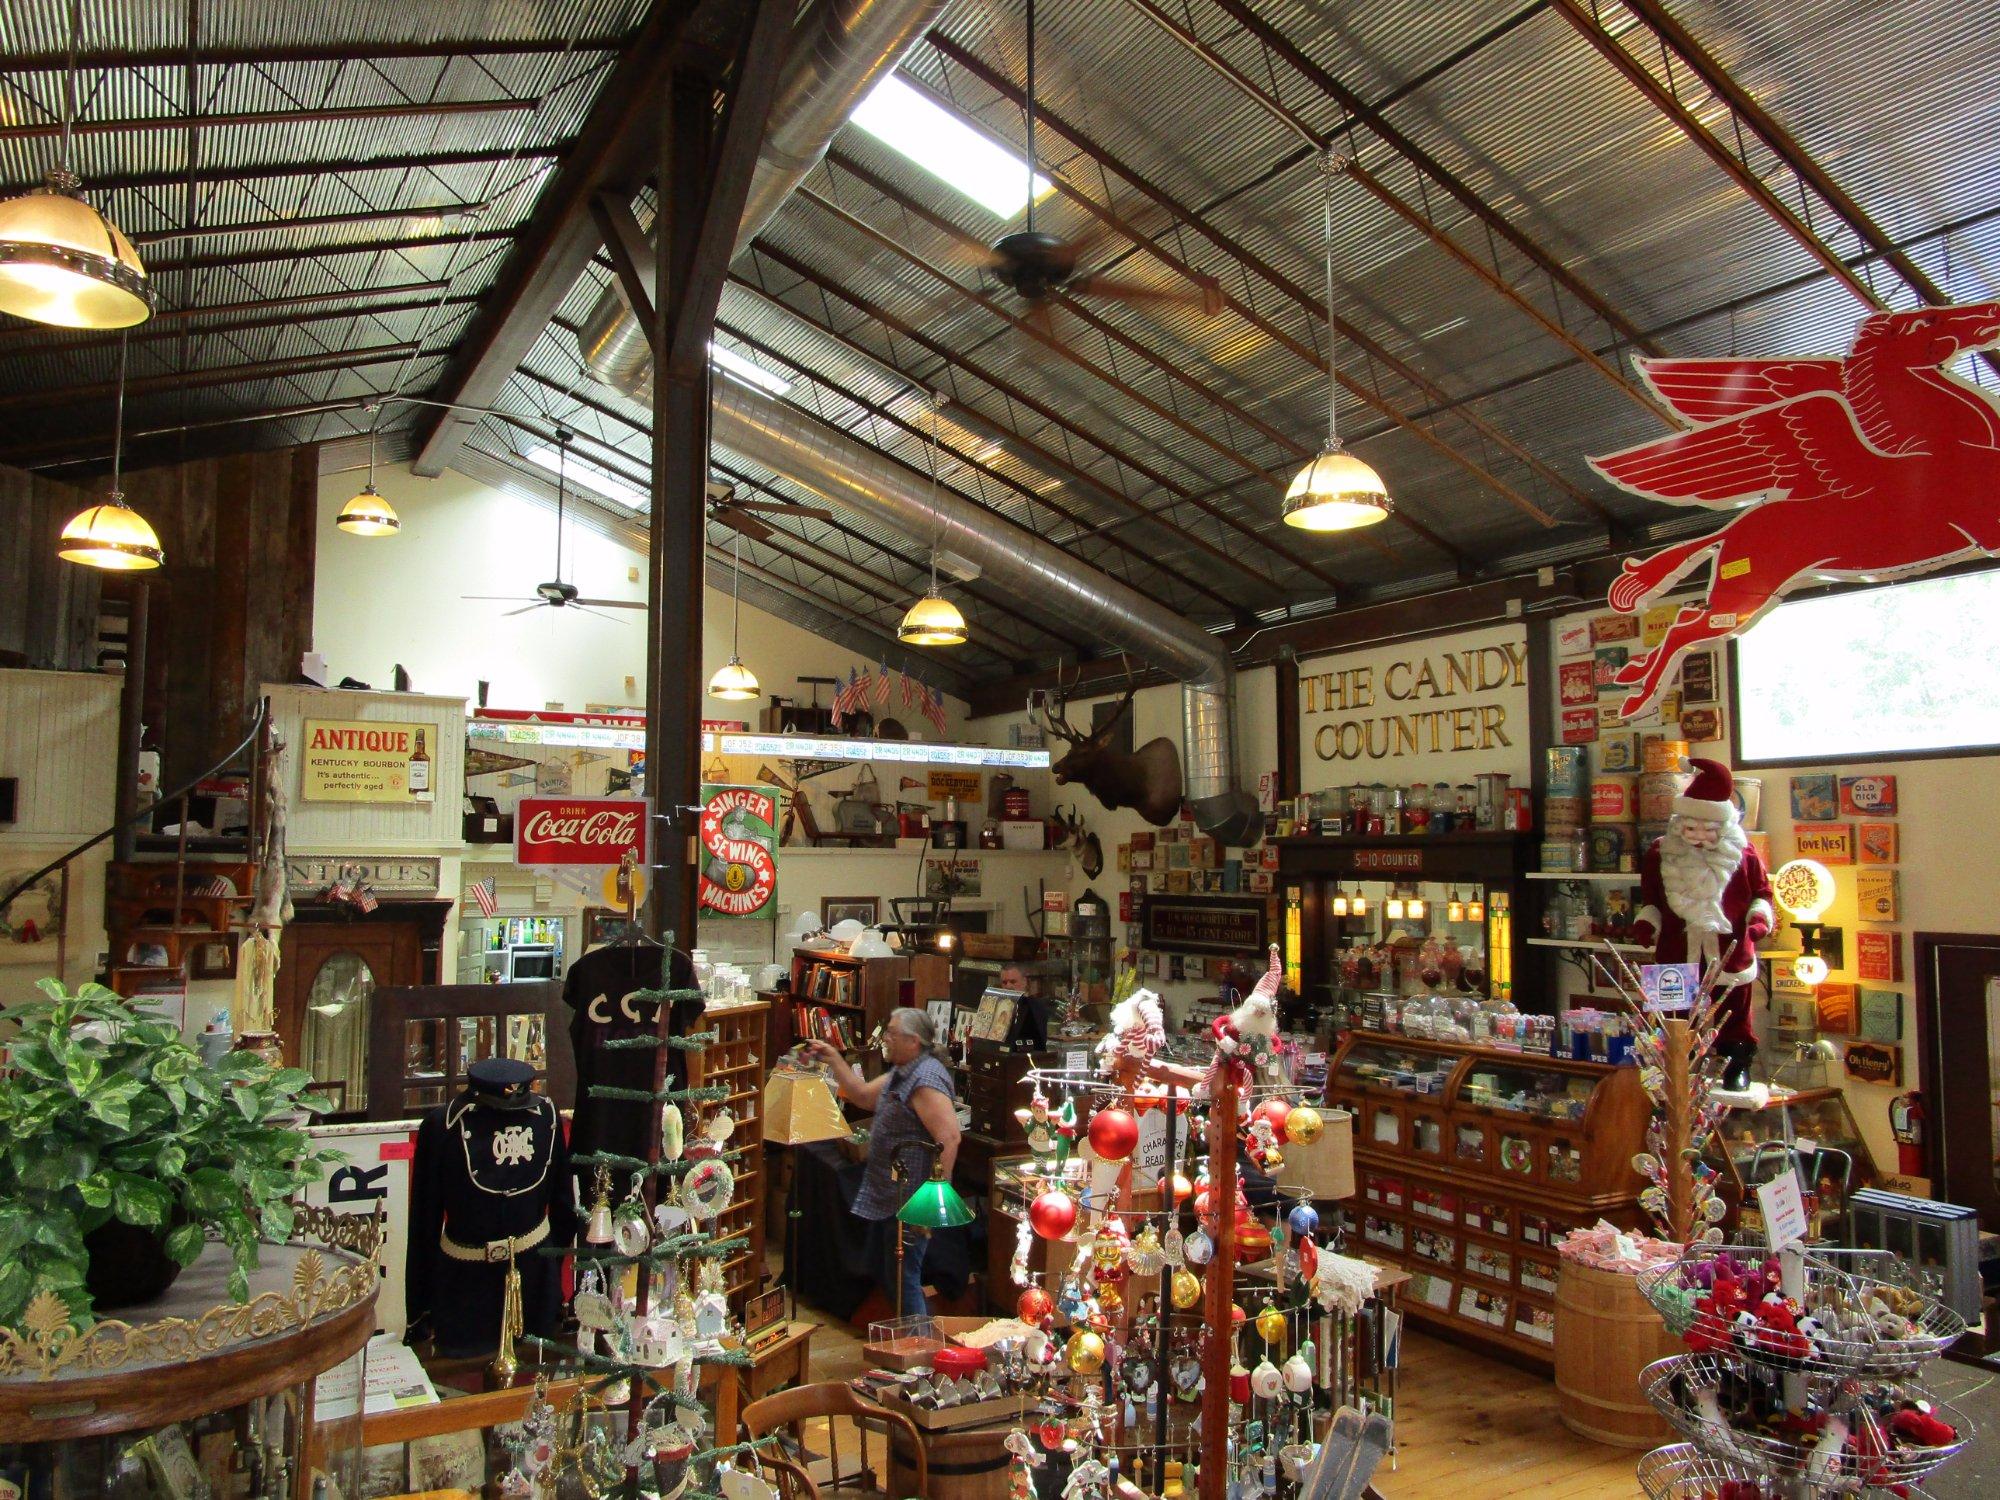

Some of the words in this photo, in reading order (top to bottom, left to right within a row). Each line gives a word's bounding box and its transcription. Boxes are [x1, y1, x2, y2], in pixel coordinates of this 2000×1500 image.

[1300, 666, 1376, 714] THE
[1384, 641, 1528, 701] CANDY
[310, 728, 409, 753] ANTIQUE
[1314, 704, 1513, 761] COUNTER
[311, 758, 359, 767] KENTUCKY
[363, 760, 405, 768] BOURBON
[332, 772, 380, 780] authentic...
[323, 782, 362, 790] perfectly
[1855, 783, 1875, 792] OLD
[560, 807, 587, 815] DRINK
[708, 792, 769, 819] SINGER
[523, 810, 641, 845] Coca-Cola
[708, 833, 767, 868] SEWING
[1797, 836, 1820, 852] LOVE
[1821, 835, 1846, 852] NEST
[1355, 853, 1361, 867] 5
[1368, 852, 1377, 867] 10
[1381, 853, 1420, 867] COUNTER
[290, 864, 432, 881] NTIQUES
[702, 883, 769, 912] MACHINES
[1556, 1050, 1573, 1059] PEZ
[1591, 1054, 1608, 1063] PEZ
[1849, 1054, 1861, 1064] Oh
[1142, 1137, 1184, 1154] CHARAER
